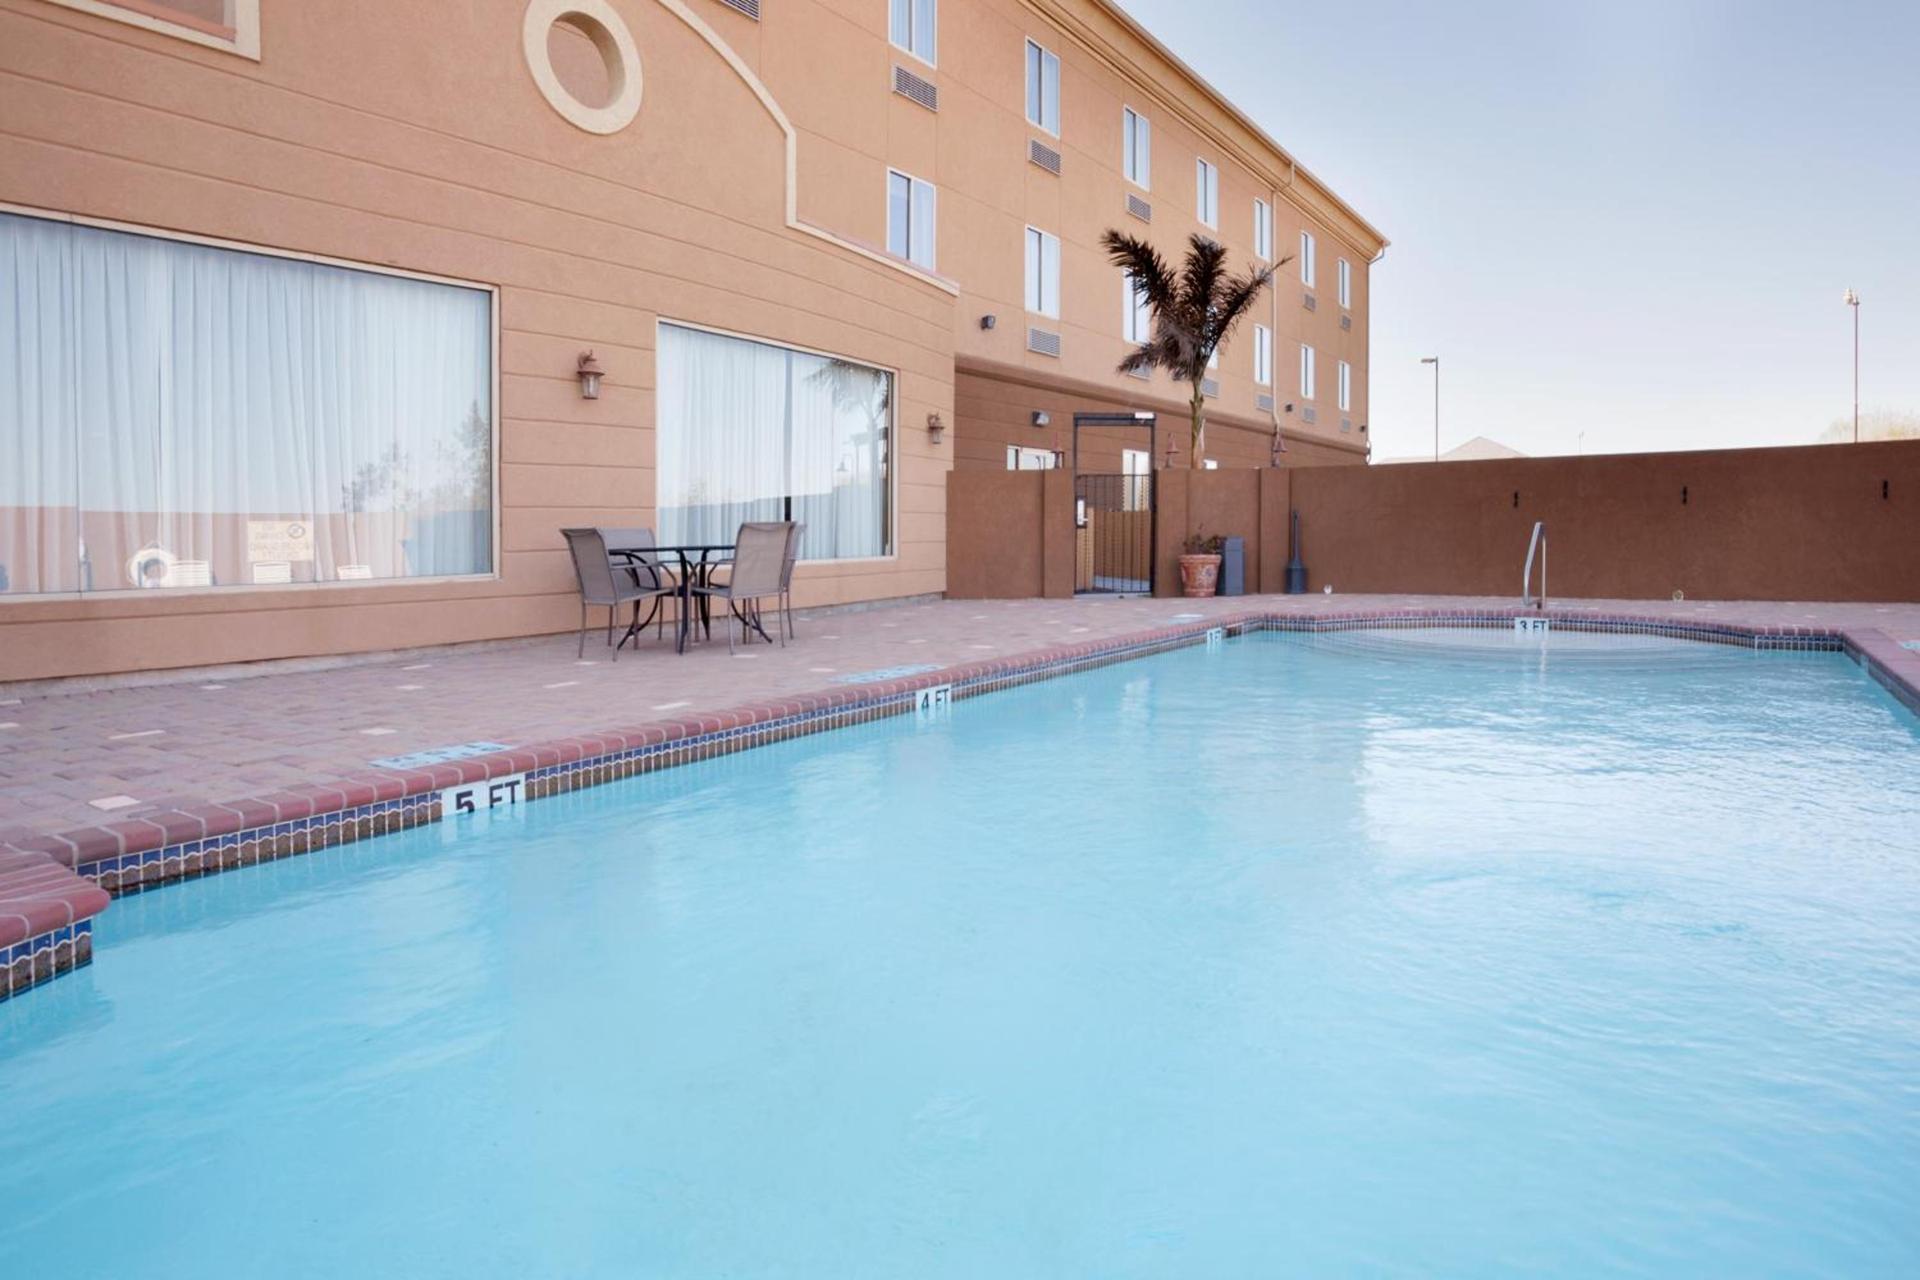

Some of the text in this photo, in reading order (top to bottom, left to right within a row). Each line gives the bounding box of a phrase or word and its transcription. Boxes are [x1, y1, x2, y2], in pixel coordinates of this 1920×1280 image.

[1533, 620, 1547, 631] FT
[921, 688, 949, 709] 4 FT
[456, 780, 520, 813] 5 FT
